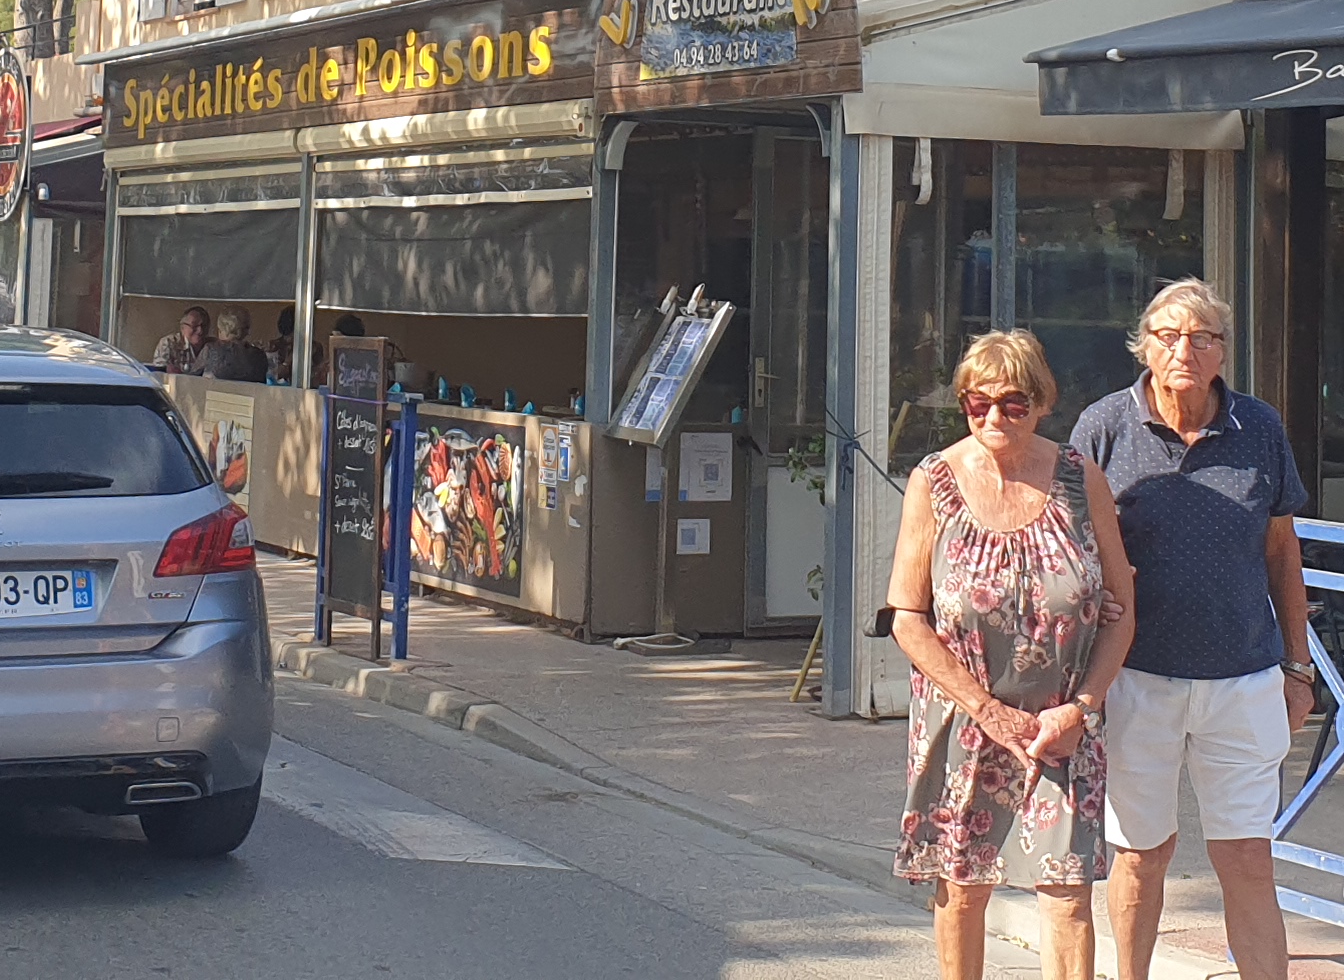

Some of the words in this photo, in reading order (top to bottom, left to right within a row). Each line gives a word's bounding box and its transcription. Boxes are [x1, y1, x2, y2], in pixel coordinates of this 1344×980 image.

[673, 48, 687, 68] 04
[688, 47, 705, 65] 94
[707, 45, 723, 64] 28
[725, 42, 741, 62] 43
[742, 40, 758, 61] 64
[123, 56, 283, 139] Spécialités
[297, 46, 340, 103] de
[354, 24, 552, 97] Poissons
[75, 591, 89, 606] 83
